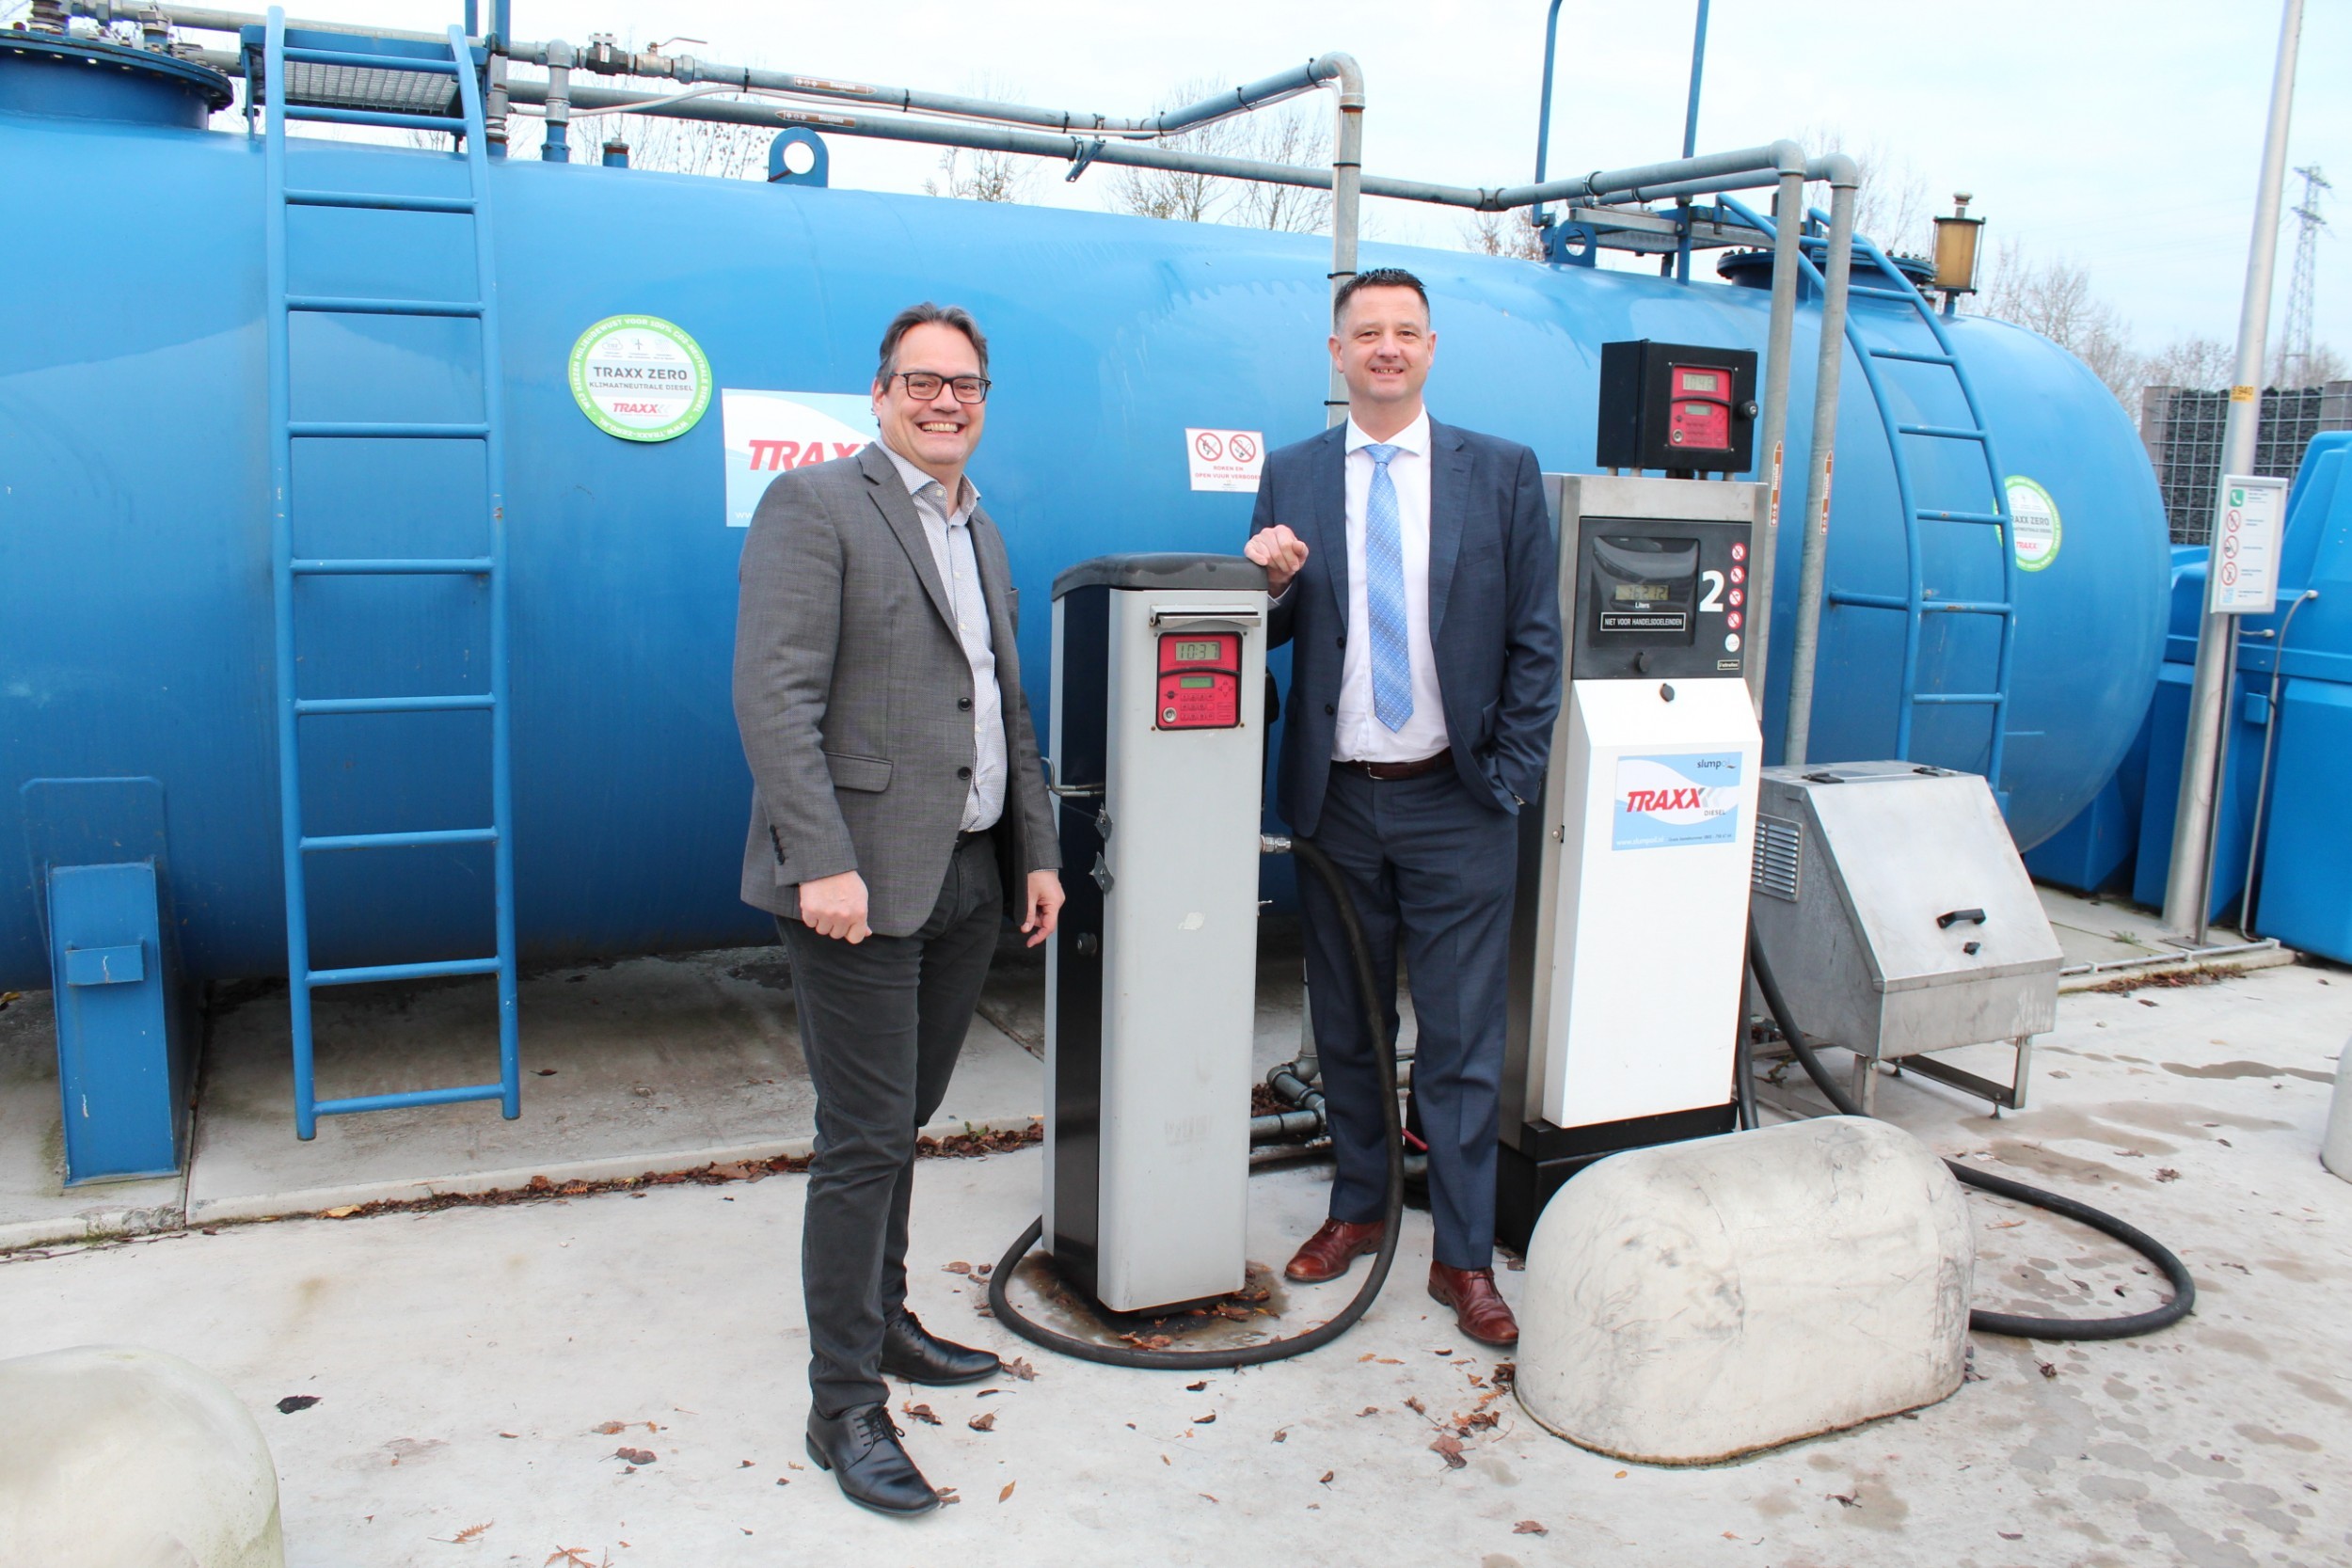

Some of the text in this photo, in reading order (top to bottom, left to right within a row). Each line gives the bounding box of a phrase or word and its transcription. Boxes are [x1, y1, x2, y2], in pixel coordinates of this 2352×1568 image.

[650, 320, 673, 333] 100%
[594, 366, 688, 380] TRAXX ZERO
[589, 382, 663, 390] KLIMAATNEUTRALE
[612, 403, 658, 414] TRAXX
[749, 439, 871, 471] TRAX
[2010, 515, 2050, 526] RAXX ZERO
[1699, 570, 1725, 612] 2
[1632, 618, 1682, 626] HANDELSDOELEINDEN
[1627, 787, 1701, 813] TRAXX
